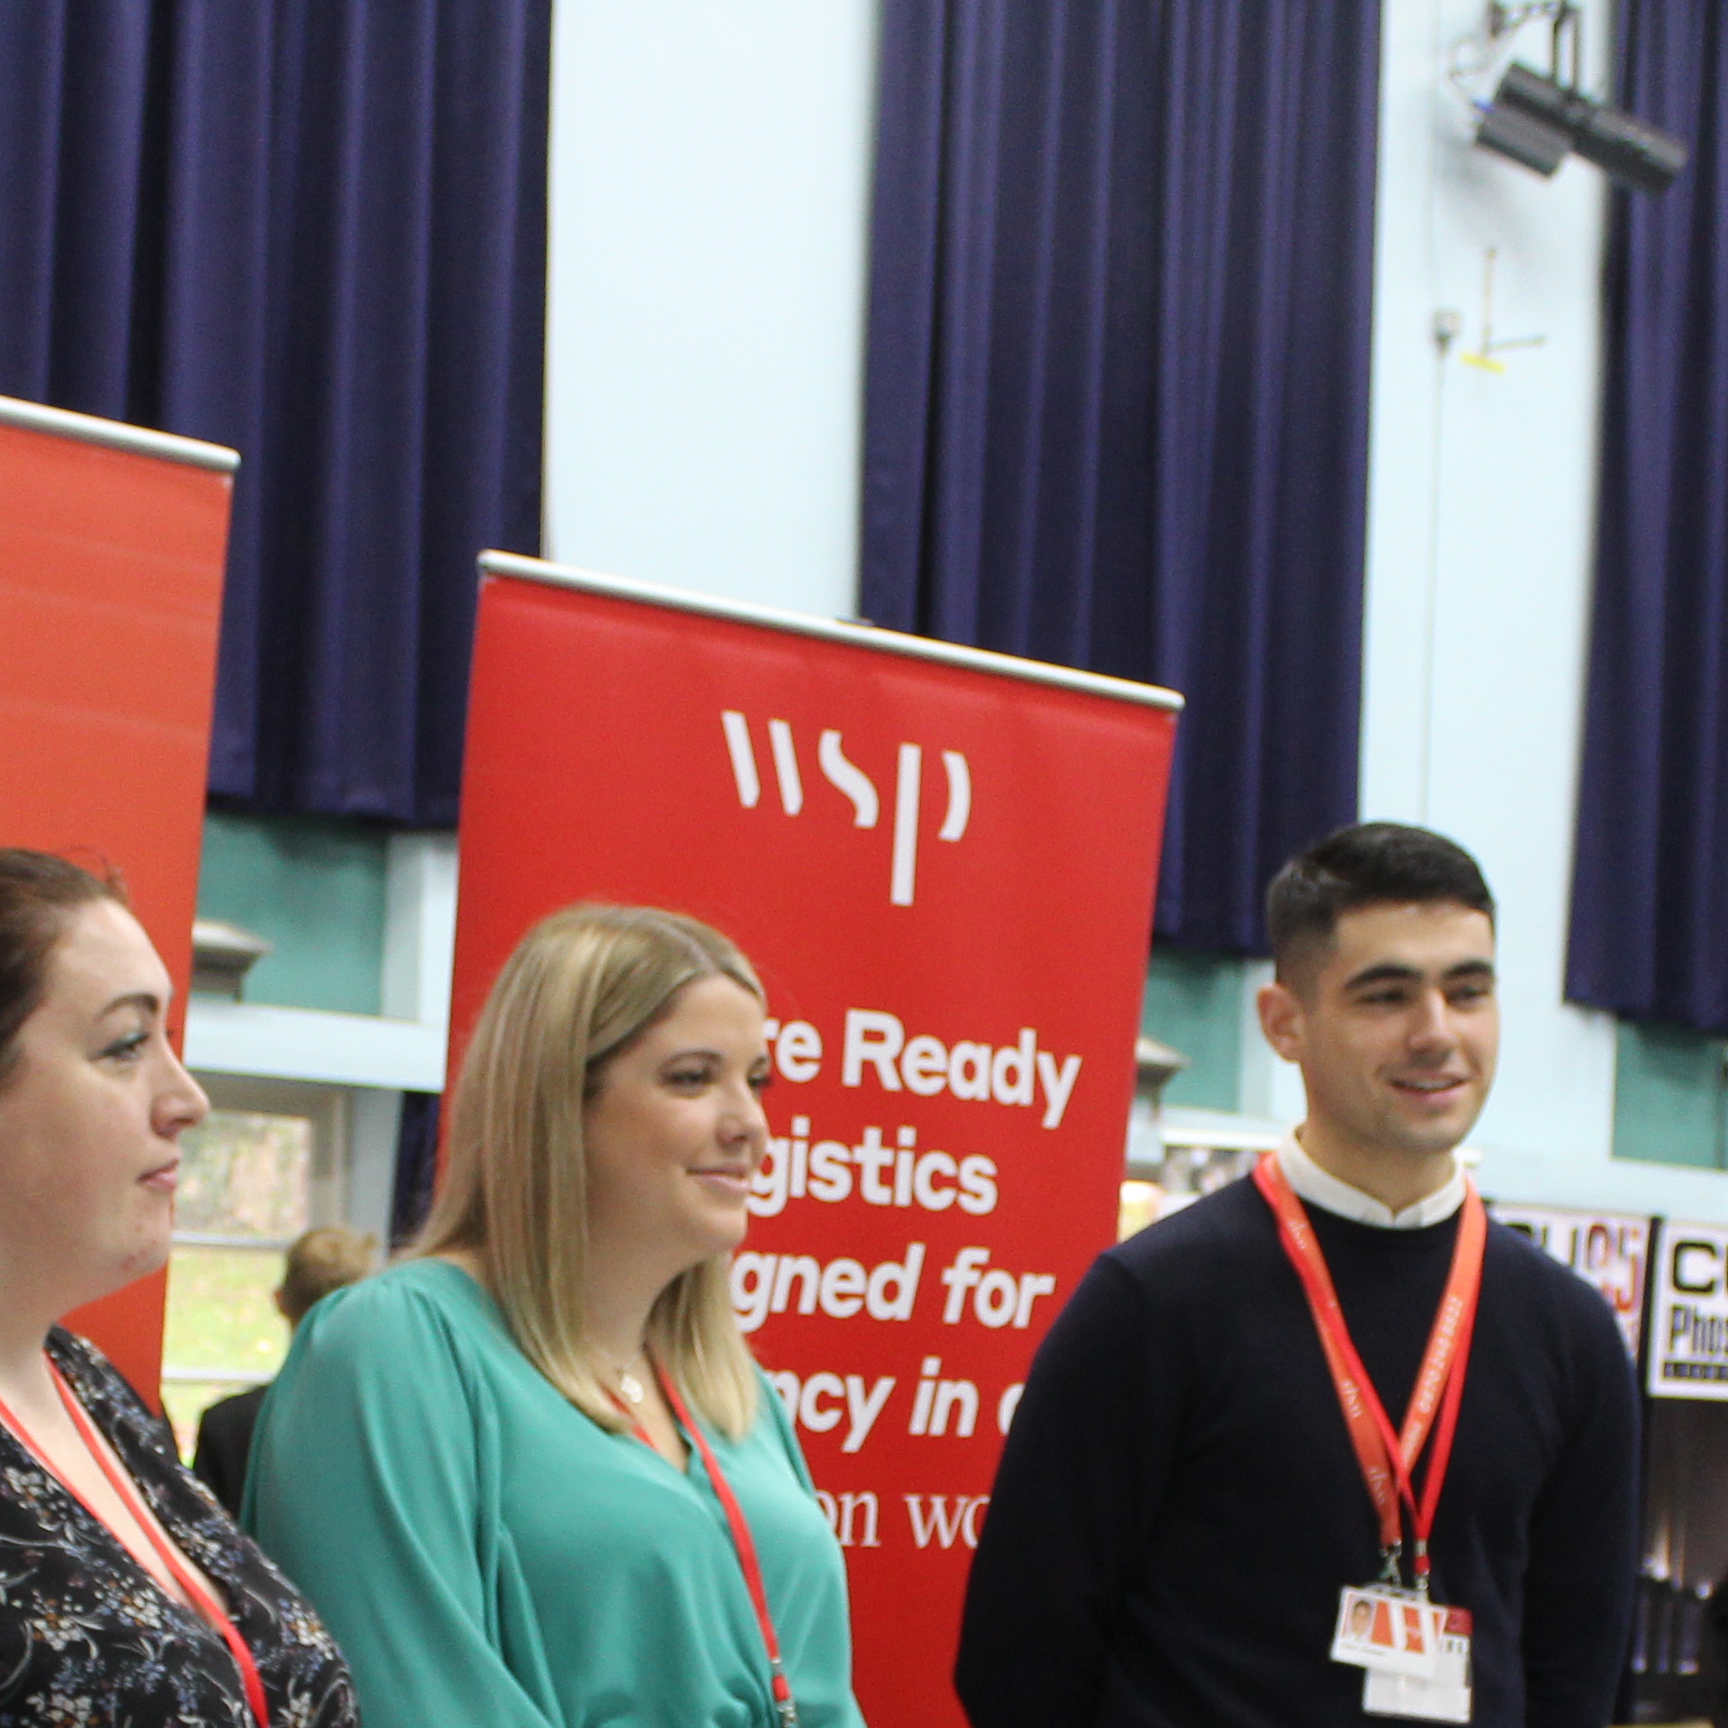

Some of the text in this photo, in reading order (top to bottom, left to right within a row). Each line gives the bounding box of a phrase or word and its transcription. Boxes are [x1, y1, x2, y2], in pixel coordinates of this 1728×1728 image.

[722, 711, 971, 906] wsp
[763, 1008, 1083, 1130] e Ready
[746, 1115, 999, 1217] gistics
[729, 1241, 1056, 1333] gned for
[908, 1356, 980, 1437] in
